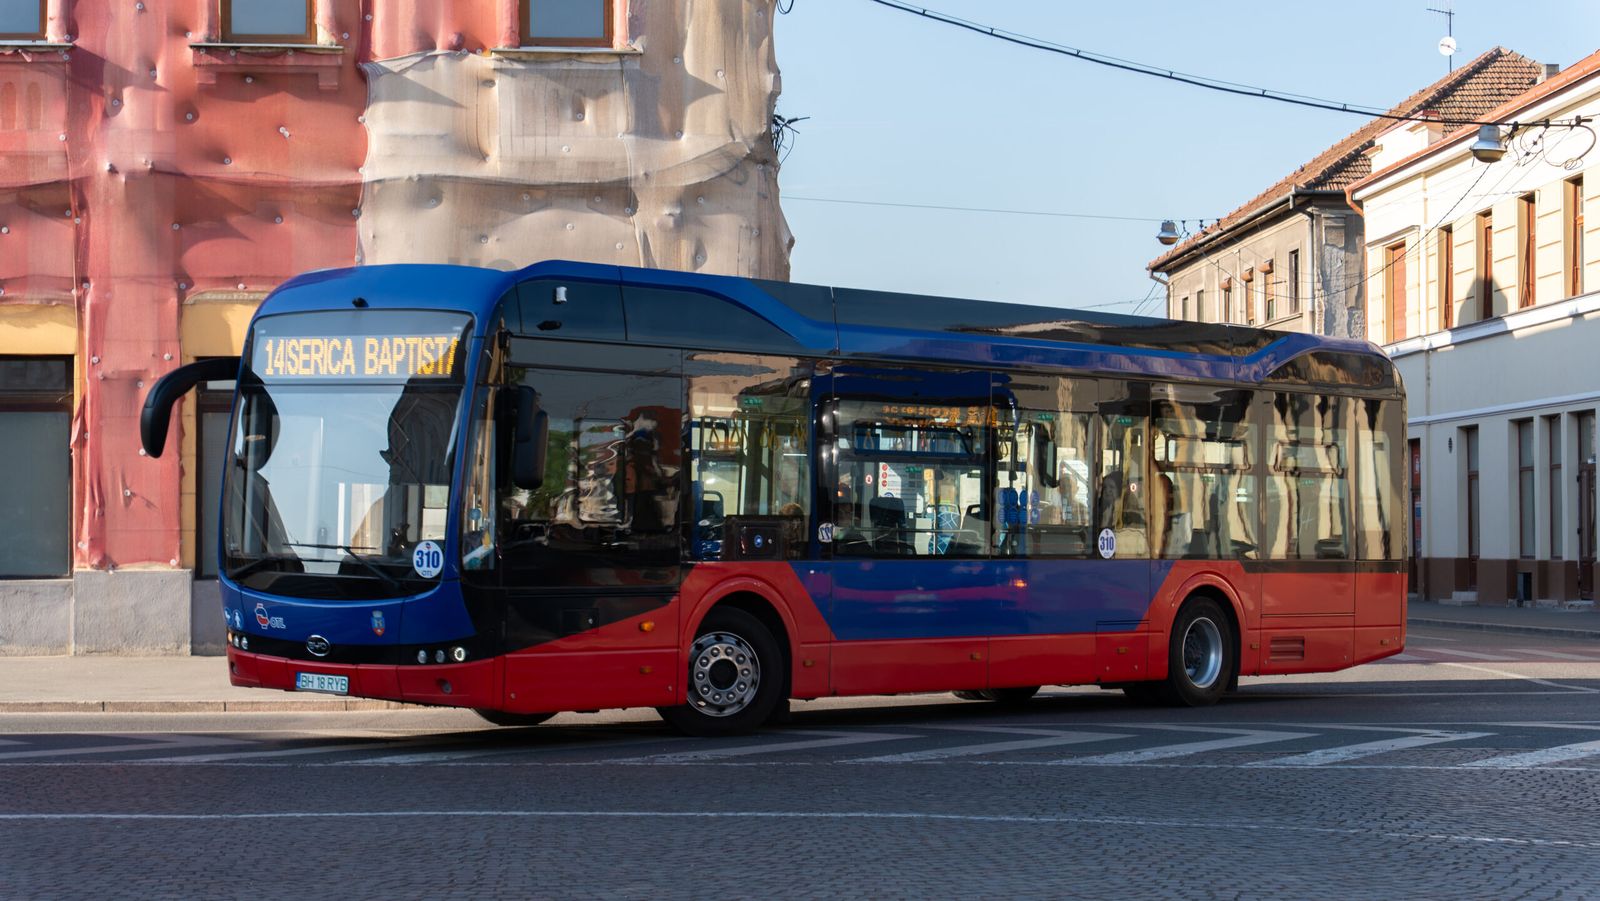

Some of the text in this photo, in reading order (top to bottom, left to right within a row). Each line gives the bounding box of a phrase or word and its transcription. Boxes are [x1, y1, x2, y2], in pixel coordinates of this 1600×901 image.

[1100, 536, 1114, 551] 310
[416, 549, 440, 568] 310
[270, 616, 286, 629] OTL
[301, 675, 347, 691] BH 18 RYB
